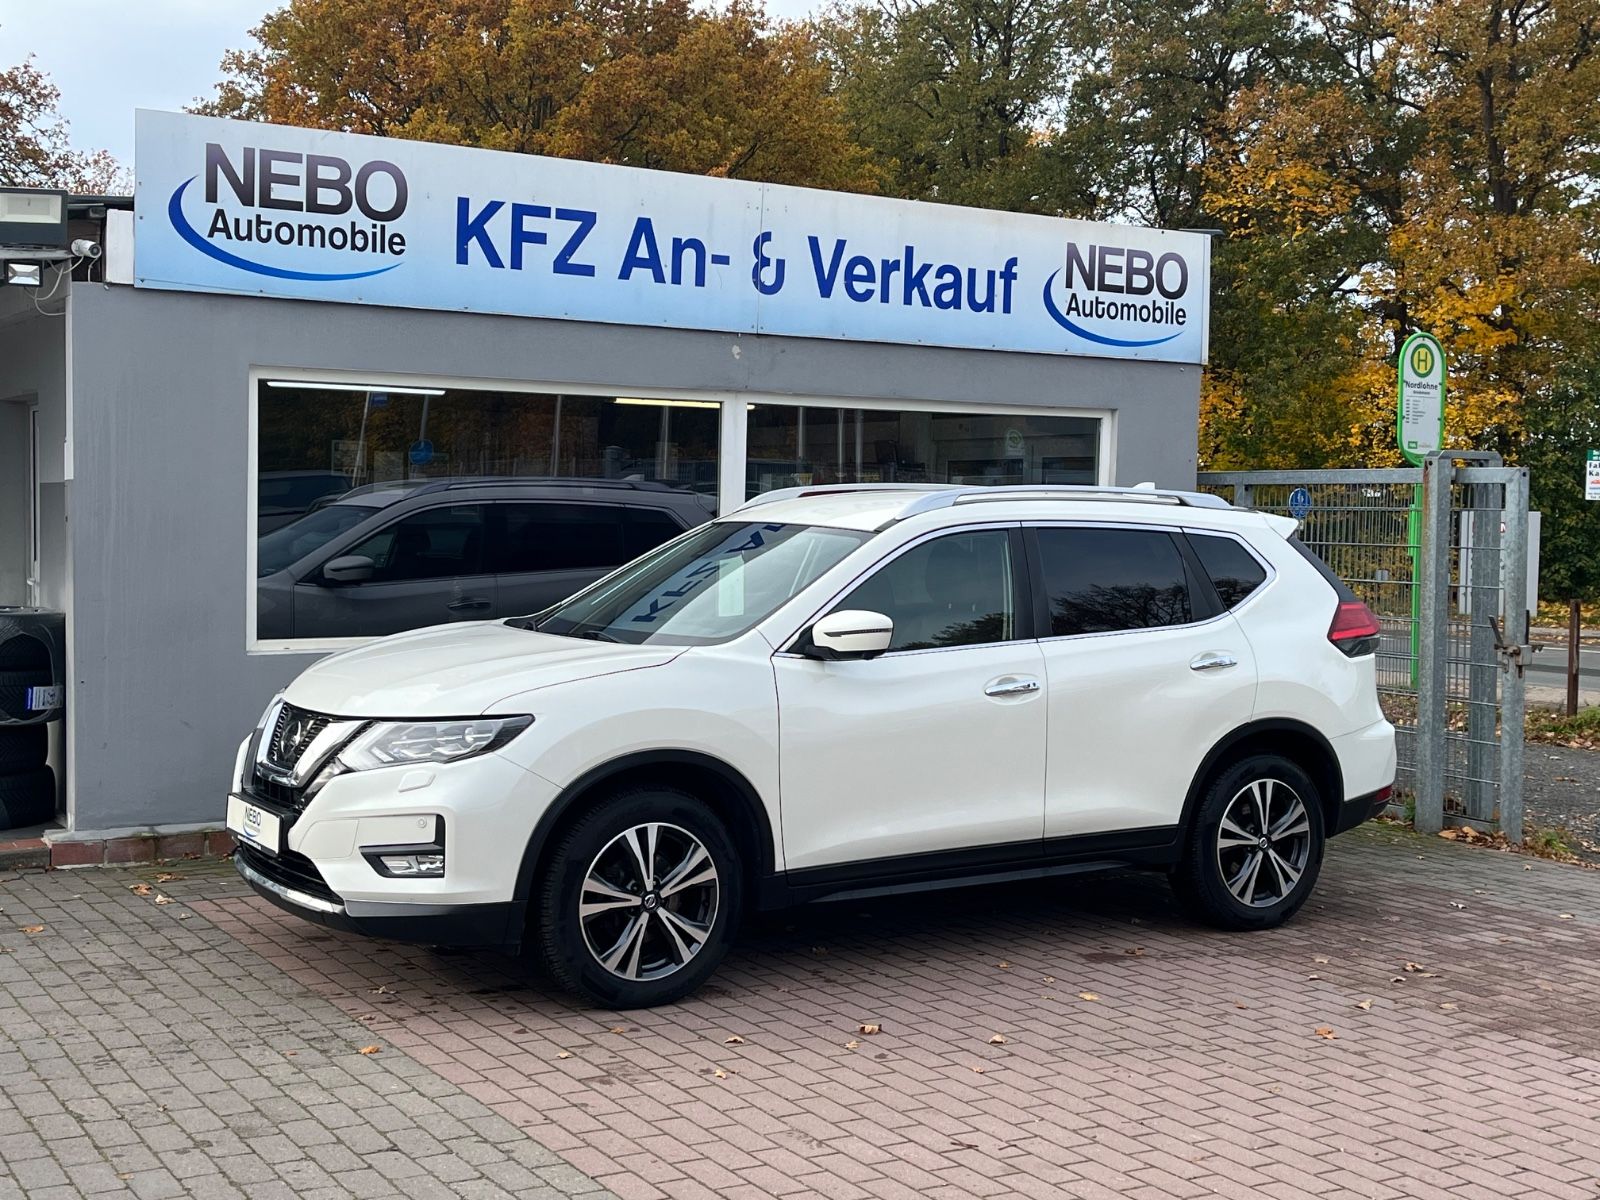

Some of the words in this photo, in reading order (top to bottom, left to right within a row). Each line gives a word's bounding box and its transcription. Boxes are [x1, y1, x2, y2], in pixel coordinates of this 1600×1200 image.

[205, 143, 408, 222] NEBO
[207, 208, 406, 256] Automobile
[456, 196, 597, 277] KFZ
[618, 216, 730, 288] An-
[752, 231, 785, 296] &
[808, 235, 1018, 314] Verkauf
[1064, 242, 1189, 300] NEBO
[1065, 293, 1187, 326] Automobile
[1417, 350, 1428, 371] H
[1405, 381, 1438, 391] Nordlohne
[245, 806, 261, 826] NEBO
